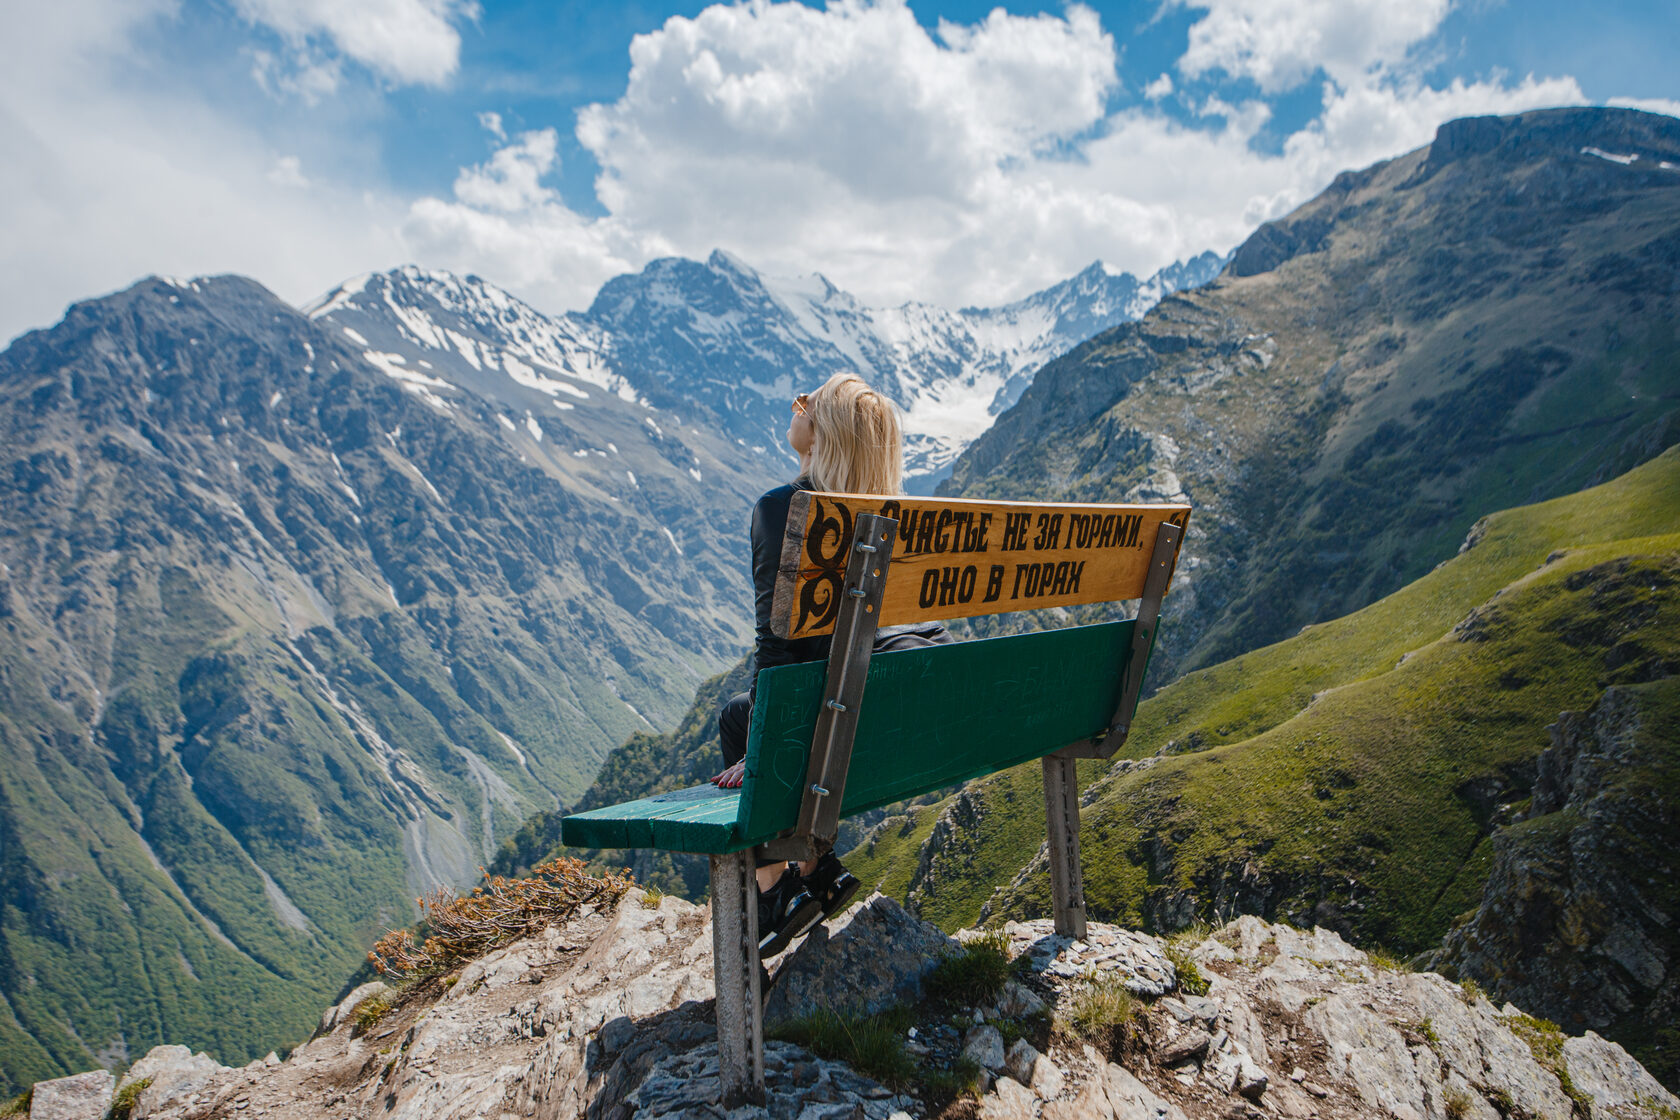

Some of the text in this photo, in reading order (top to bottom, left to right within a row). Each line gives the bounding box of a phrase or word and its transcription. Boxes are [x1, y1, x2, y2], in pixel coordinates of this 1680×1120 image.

[1001, 513, 1033, 551] НЕ
[1033, 513, 1064, 551] ЗА
[1064, 513, 1144, 551] ГОРАМИ,
[918, 561, 1086, 609] ОНО В ГОРАХ
